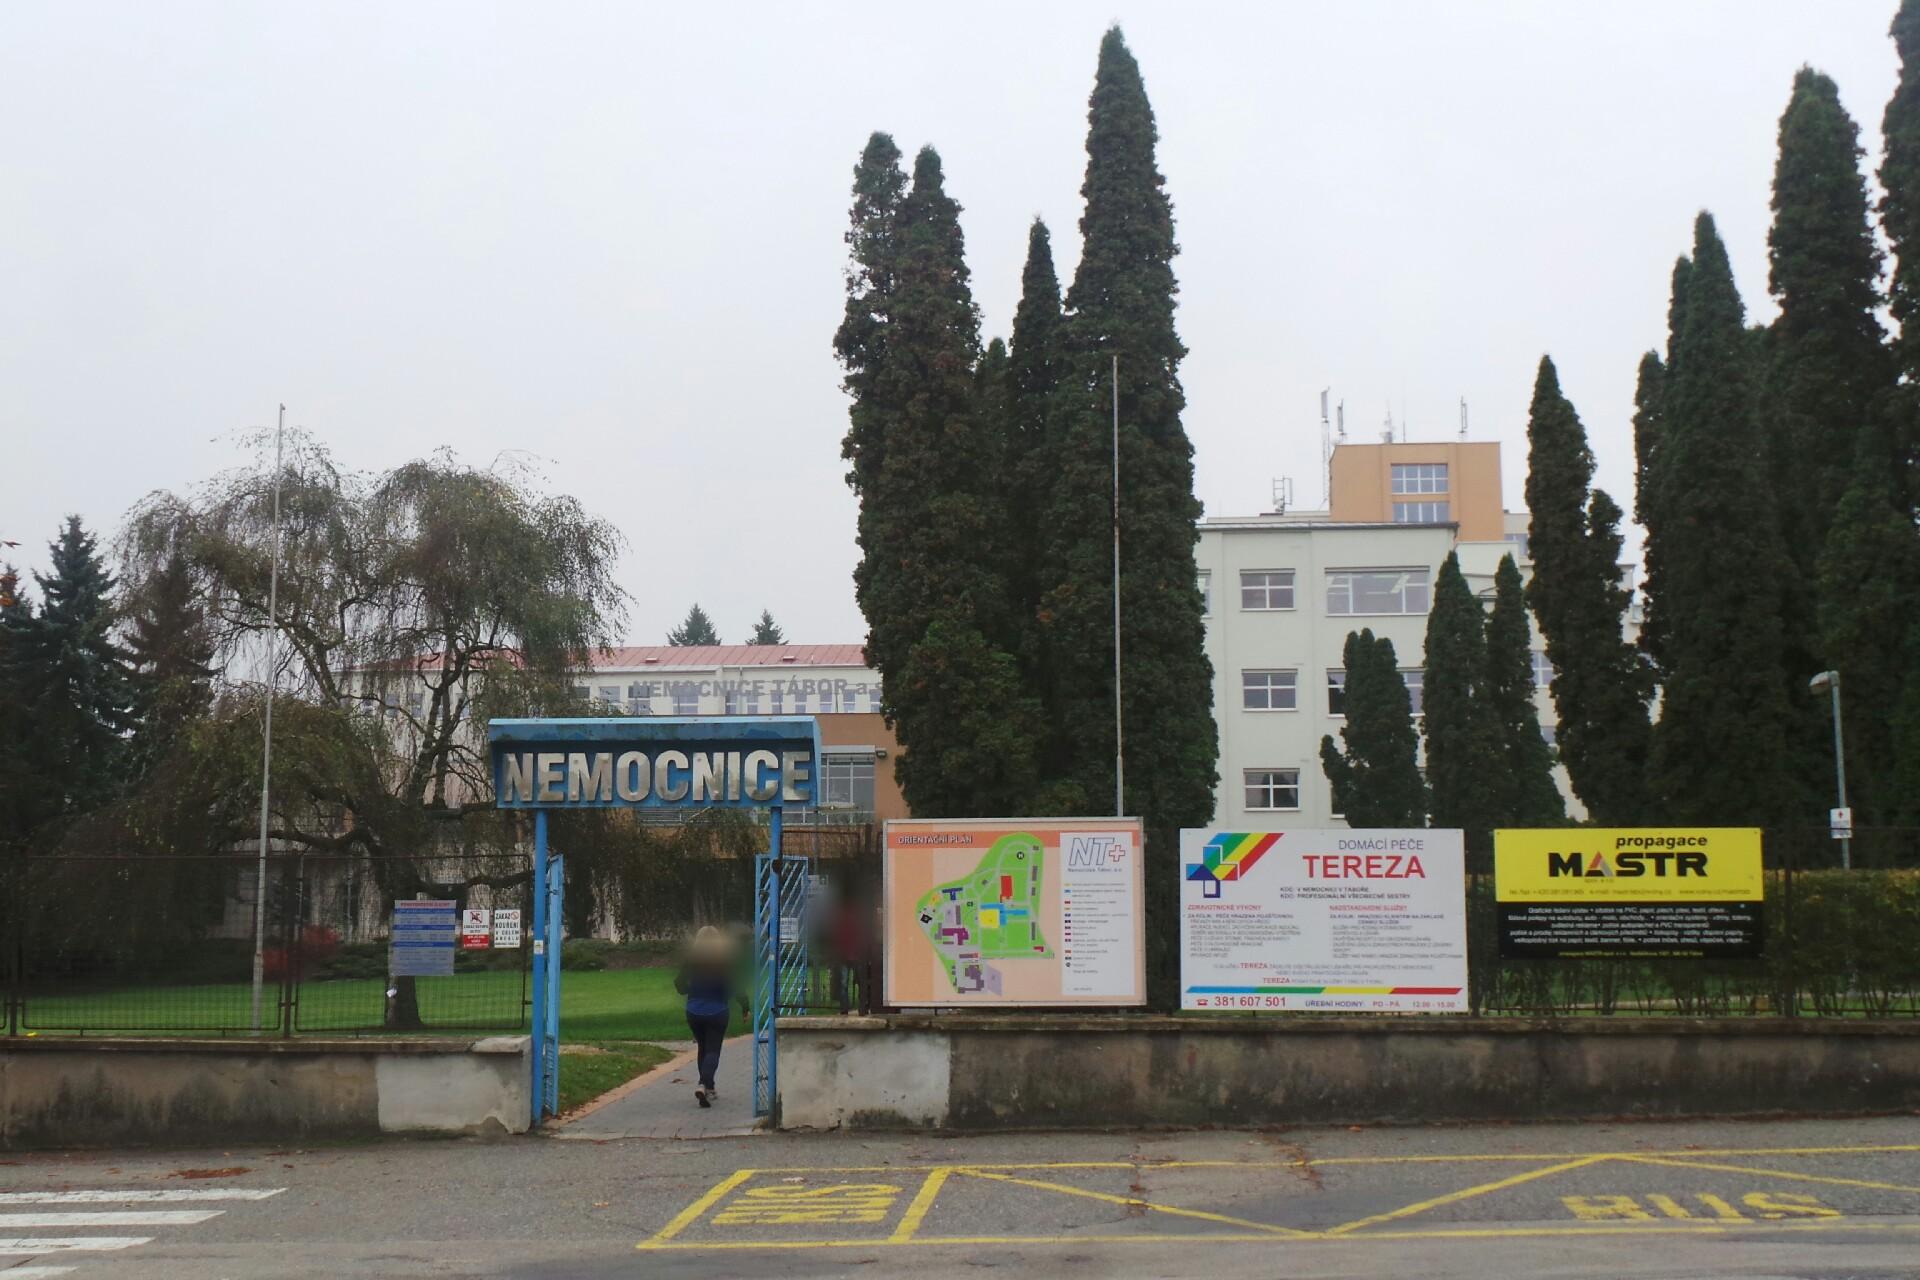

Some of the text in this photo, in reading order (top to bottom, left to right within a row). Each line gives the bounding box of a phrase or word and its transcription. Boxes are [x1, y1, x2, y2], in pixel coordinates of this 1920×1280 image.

[633, 679, 766, 697] NEMOCNICE
[769, 675, 848, 696] TÁBOR
[503, 750, 811, 802] NEMOCNICE
[897, 833, 973, 845] ORIENTAČNÍ PLÁN
[1338, 838, 1424, 851] DOMÁCÍ PÉČE
[1615, 835, 1708, 849] propagace
[1302, 855, 1426, 878] TEREZA
[1548, 851, 1709, 878] MASTR
[1214, 996, 1287, 1007] 381 607 501
[1561, 1192, 1845, 1223] BUS
